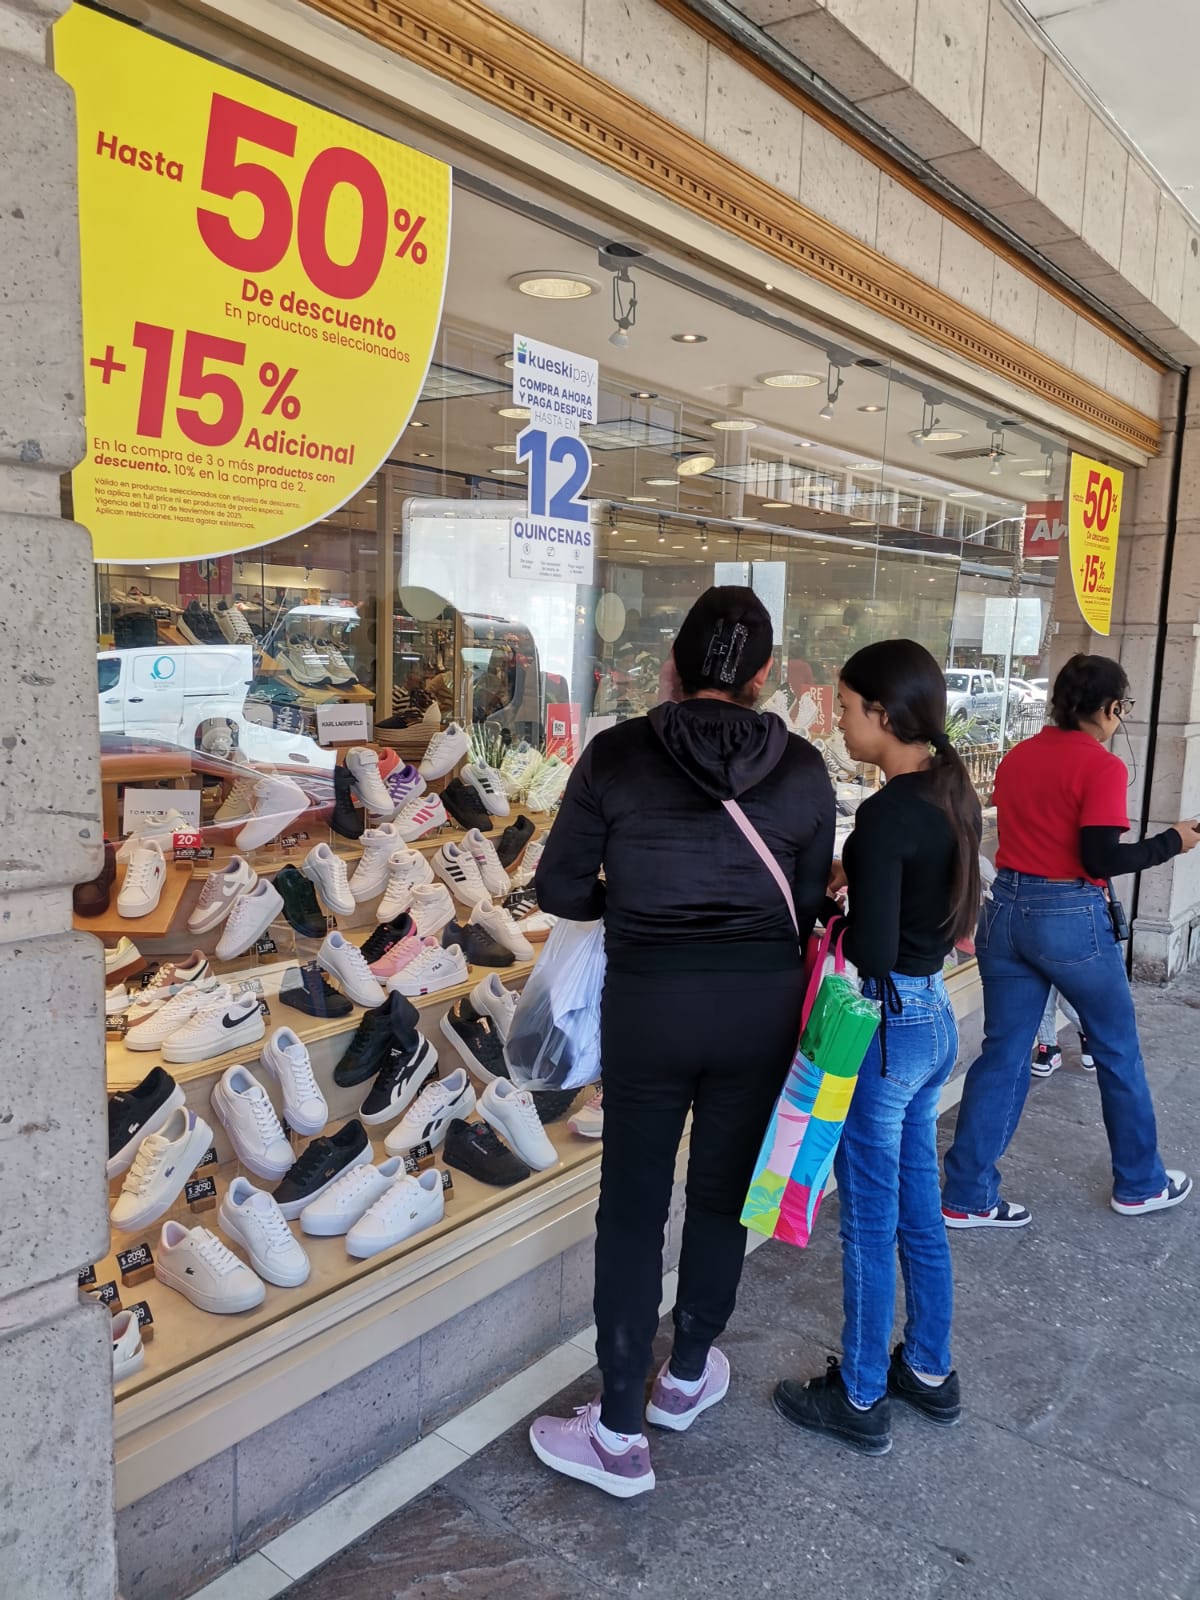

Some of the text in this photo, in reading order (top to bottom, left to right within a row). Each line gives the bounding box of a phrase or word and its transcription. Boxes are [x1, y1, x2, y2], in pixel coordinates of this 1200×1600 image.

[96, 131, 184, 182] Hasta
[241, 278, 396, 341] De descuento
[225, 302, 411, 363] En productos seleccionados
[519, 376, 592, 406] COMPRA AHORA
[519, 391, 593, 421] Y PAGA DESPUÉS
[534, 411, 576, 431] HASTA EN
[94, 437, 336, 484] En la compra de 3 o más productos con
[244, 428, 355, 465] Adicional
[94, 453, 306, 493] descuento. 10% en la compra de 2.
[519, 428, 589, 523] 12
[95, 487, 105, 496] No
[107, 489, 130, 499] aplica
[193, 498, 227, 509] productos
[95, 497, 128, 509] Vigencia
[130, 500, 141, 509] del
[132, 482, 167, 494] productos
[169, 486, 217, 499] seleccionados
[95, 506, 124, 516] Aplican
[514, 521, 591, 547] QUINCENAS
[810, 687, 823, 700] RE
